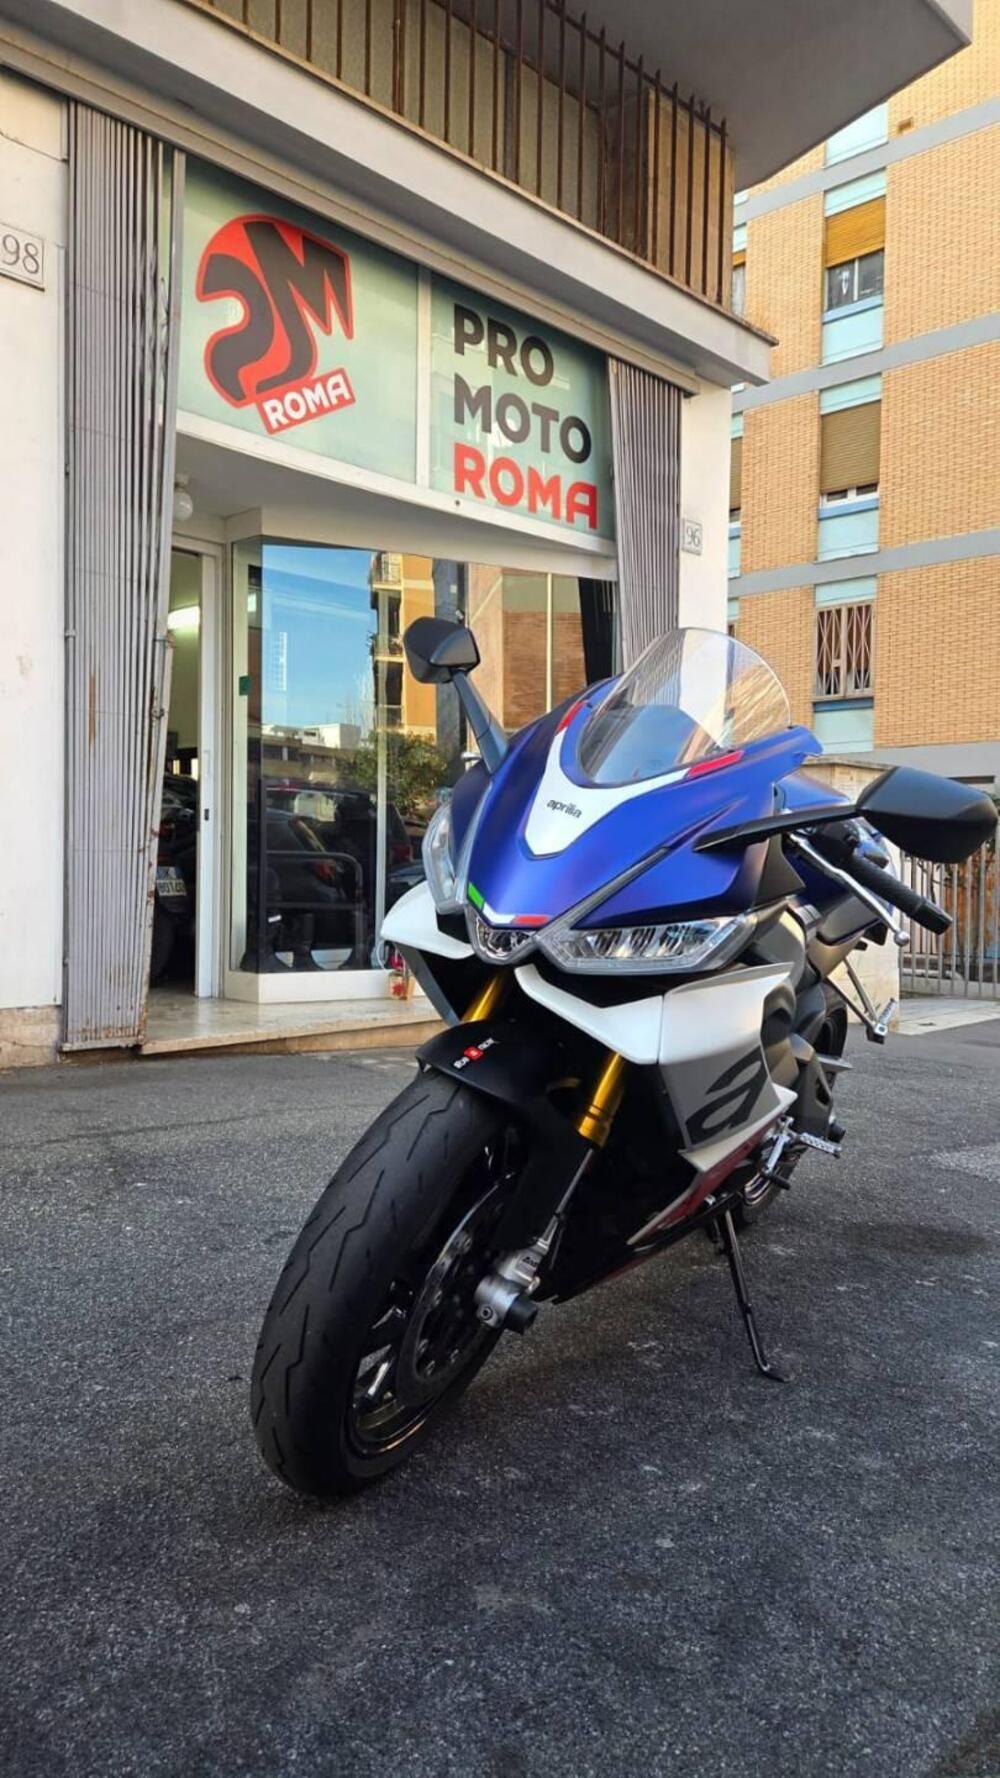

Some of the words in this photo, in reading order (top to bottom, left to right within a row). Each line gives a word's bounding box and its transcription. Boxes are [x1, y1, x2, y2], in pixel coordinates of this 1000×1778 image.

[2, 233, 40, 275] 98
[453, 303, 555, 387] PRO
[262, 373, 352, 430] ROMA
[453, 372, 592, 464] MOTO
[453, 441, 598, 530] ROMA
[686, 526, 701, 548] 96
[546, 799, 583, 819] aprilia
